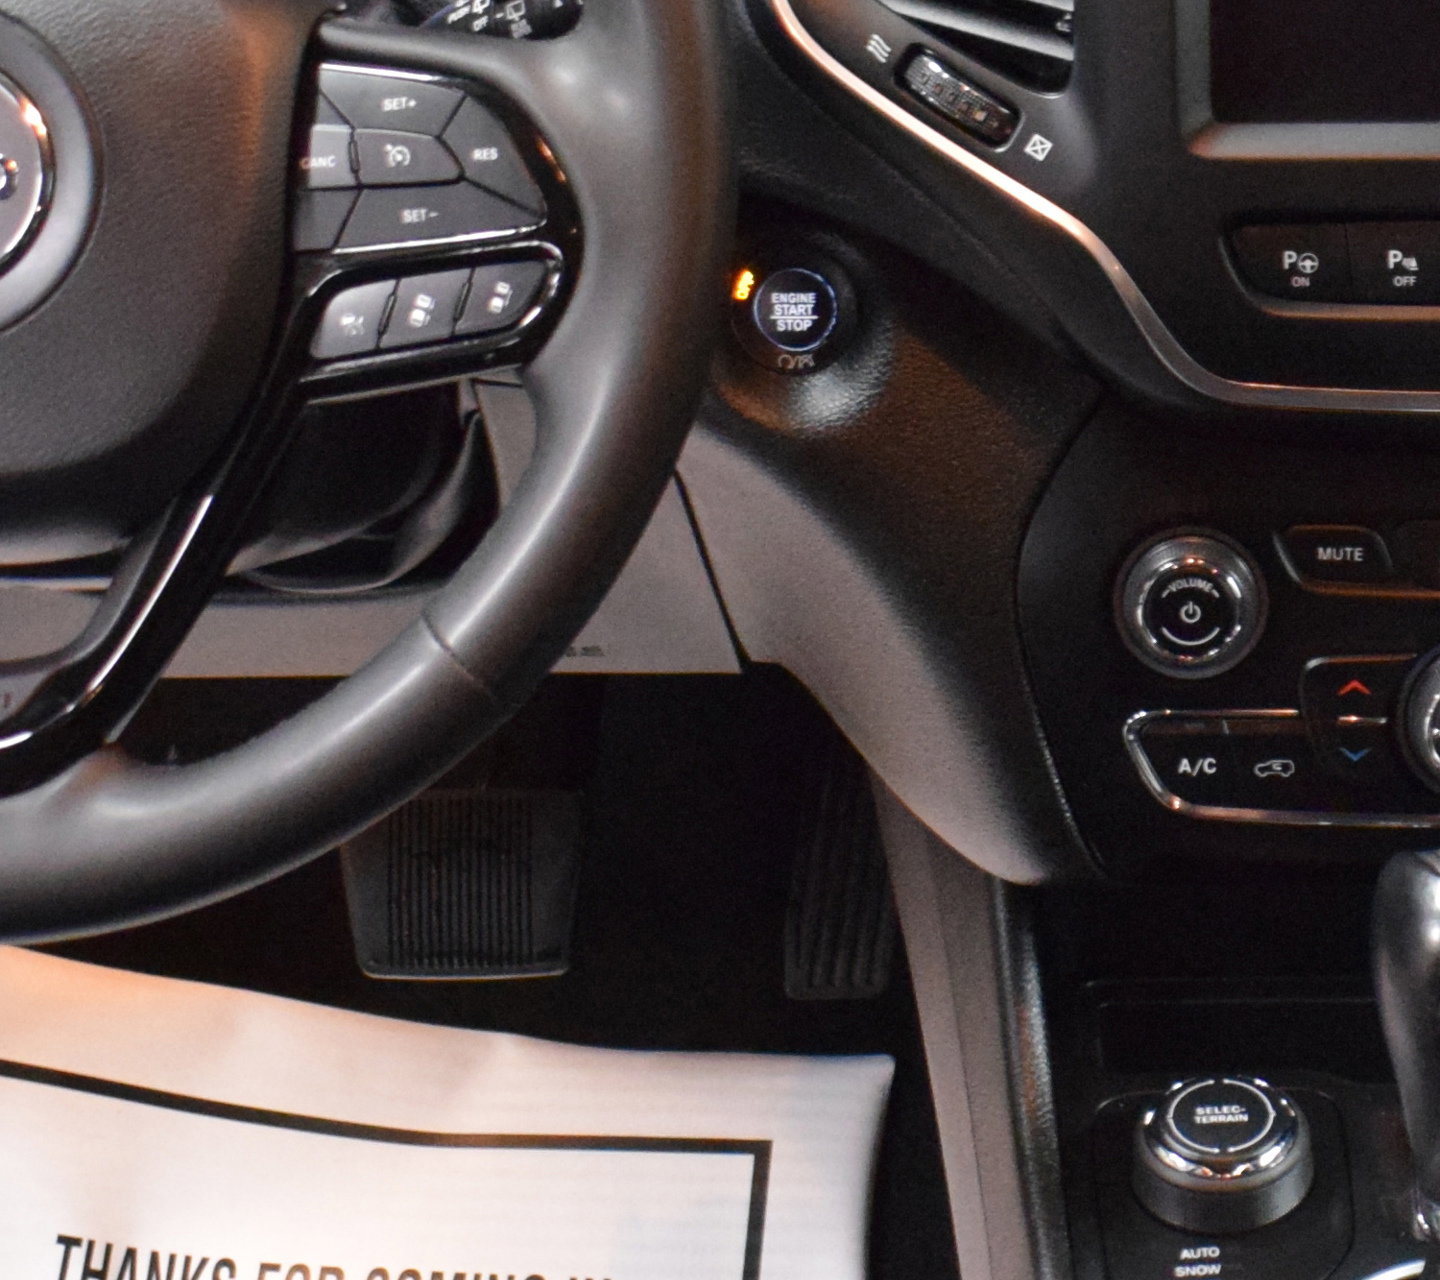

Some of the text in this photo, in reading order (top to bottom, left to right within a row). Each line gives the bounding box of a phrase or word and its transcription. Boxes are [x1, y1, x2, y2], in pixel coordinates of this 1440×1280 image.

[472, 148, 499, 162] RES
[1291, 276, 1310, 288] ON
[1393, 276, 1417, 287] OFF
[771, 292, 817, 304] ENGINE
[773, 304, 815, 316] START
[776, 320, 813, 332] STOP
[1317, 547, 1364, 562] MUTE
[1169, 577, 1214, 594] VOLUME
[1178, 757, 1217, 776] A/C
[1194, 1104, 1247, 1116] SELEC-
[1194, 1113, 1249, 1124] TERRAIN
[1180, 1246, 1220, 1260] AUTO
[1174, 1264, 1222, 1277] SNOW
